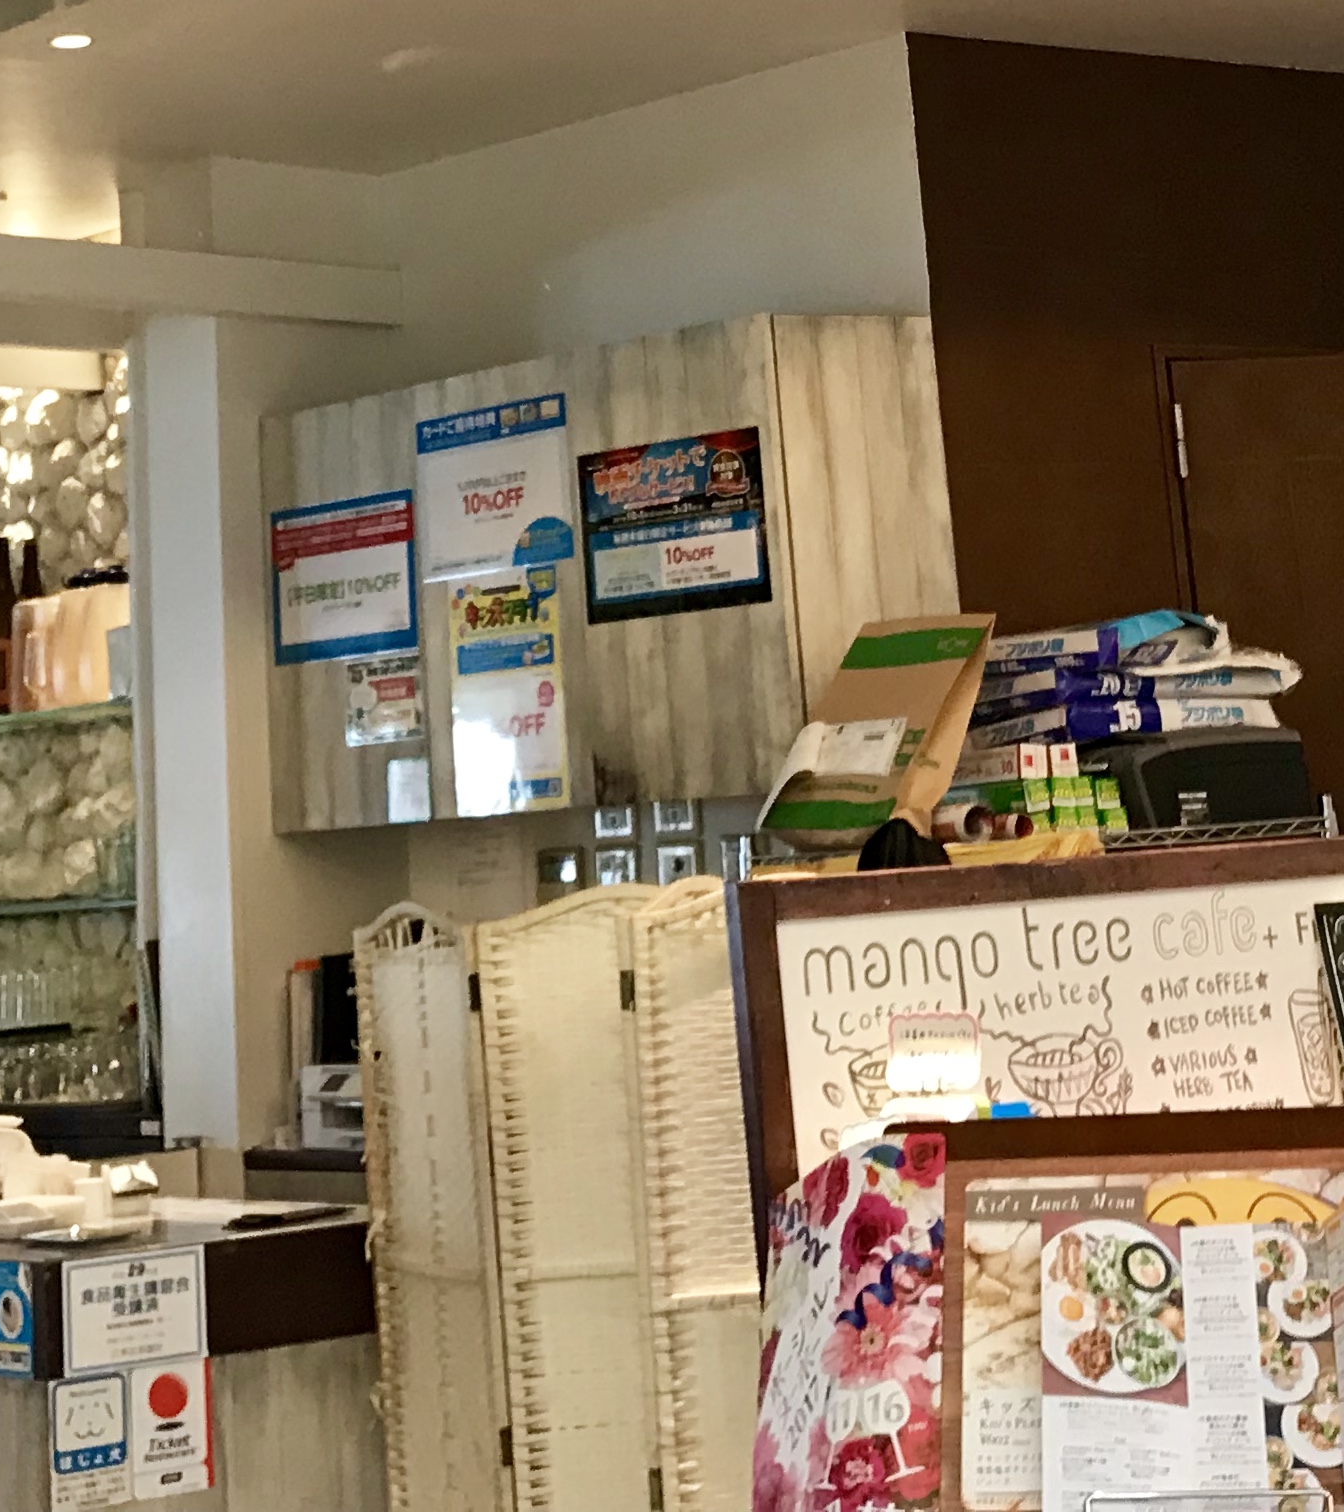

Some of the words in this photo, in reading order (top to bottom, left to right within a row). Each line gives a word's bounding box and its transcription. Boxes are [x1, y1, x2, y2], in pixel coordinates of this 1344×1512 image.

[803, 930, 999, 1013] mango
[1022, 905, 1133, 972] tree
[994, 980, 1051, 1021] herb
[1164, 1013, 1199, 1039] ICED
[1168, 1044, 1238, 1075] VARIOUS
[1173, 1073, 1215, 1099] HERB
[1220, 1071, 1254, 1094] TEA
[1030, 1193, 1081, 1212] Lunch
[1090, 1191, 1137, 1211] Menu
[866, 1390, 905, 1427] 16
